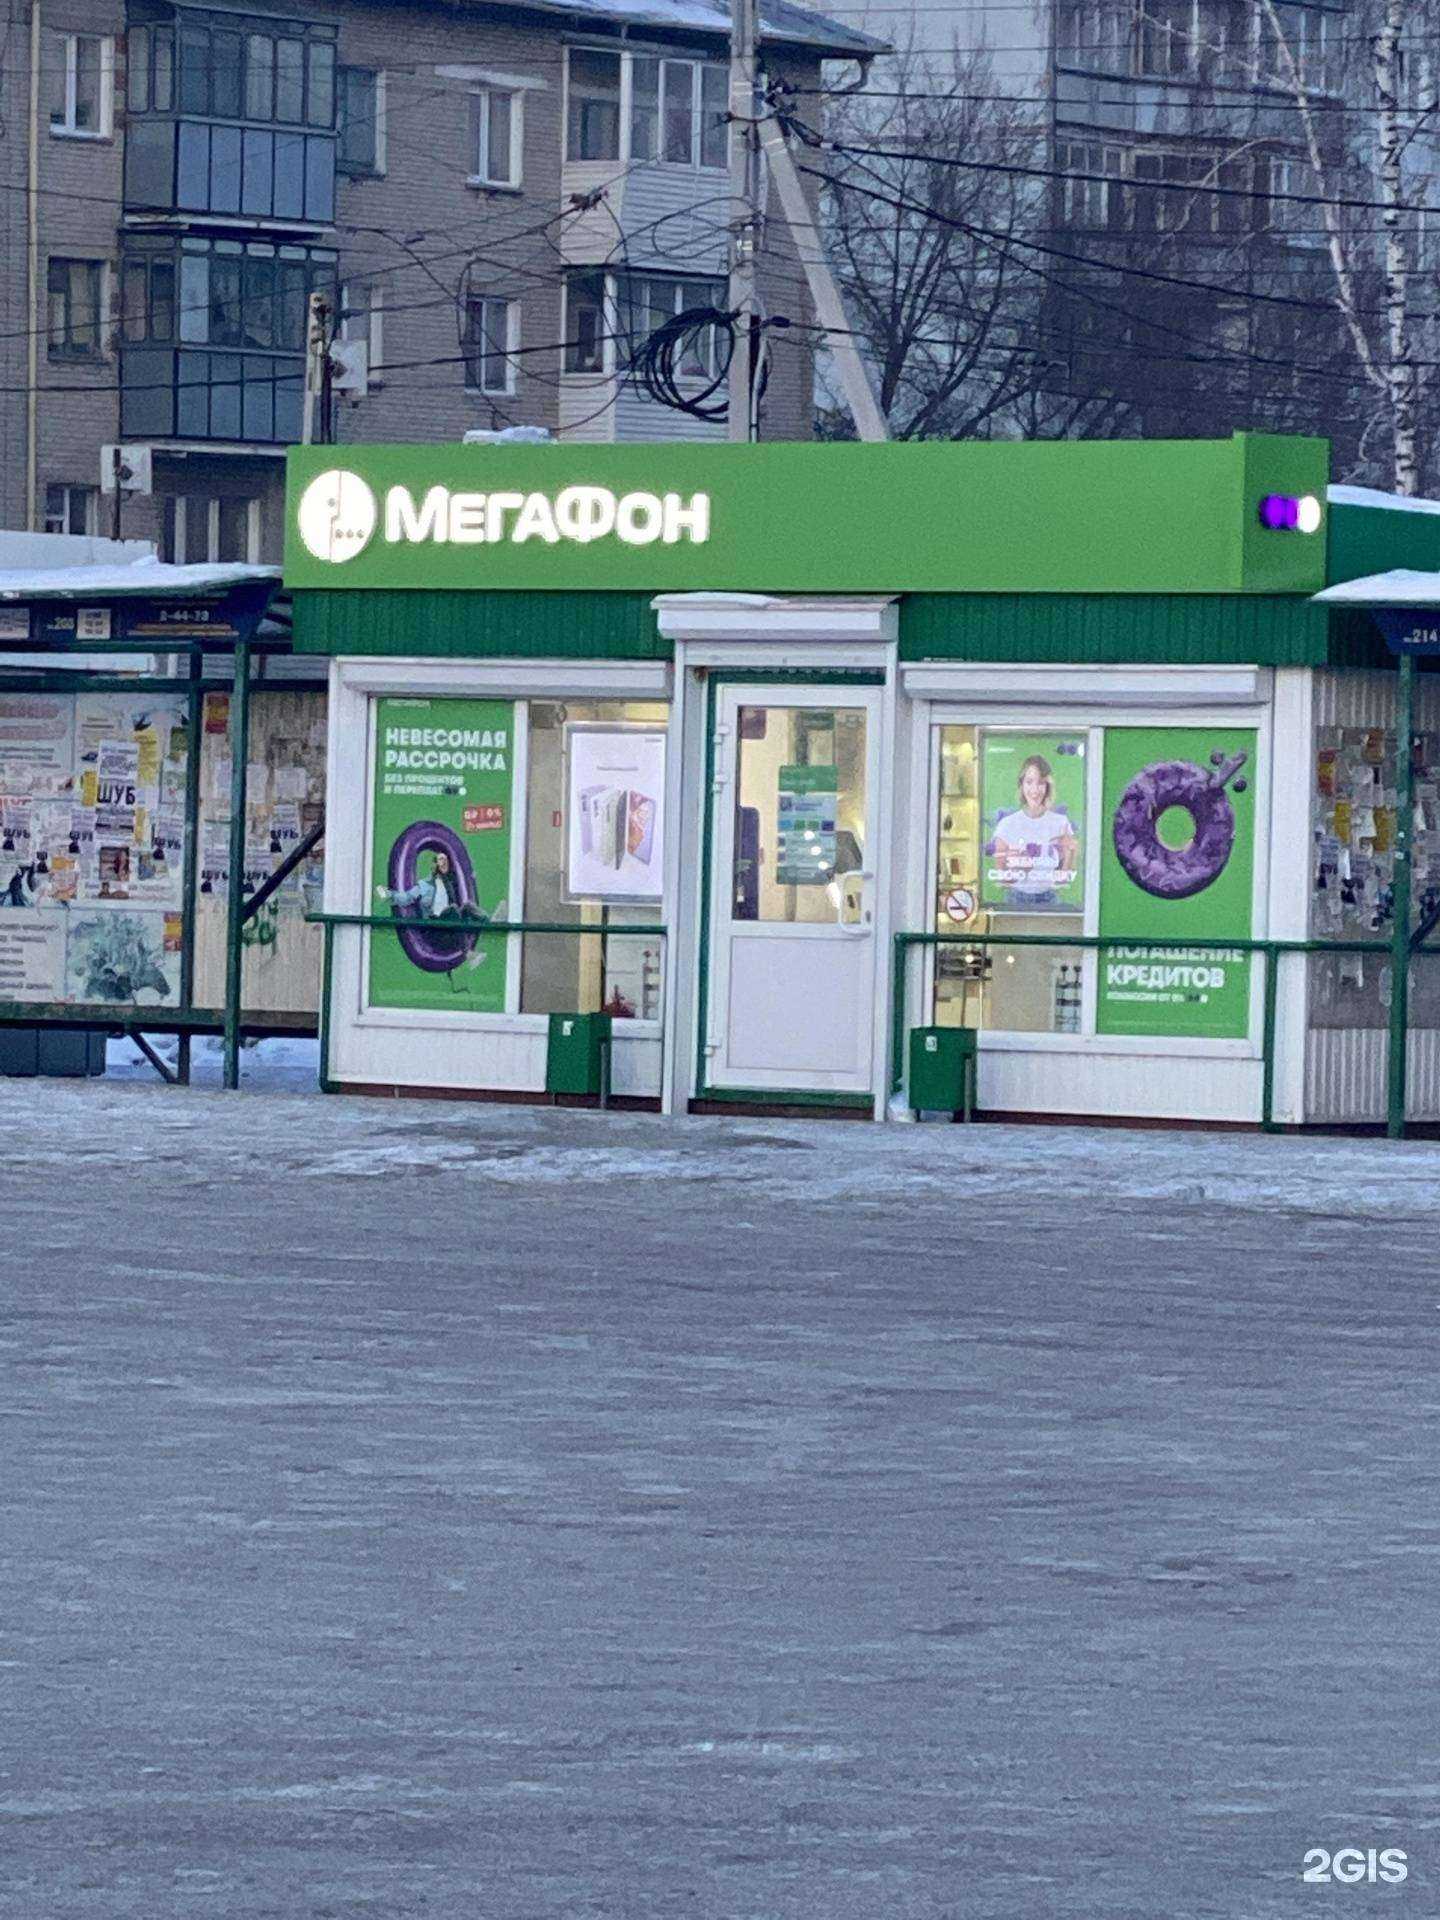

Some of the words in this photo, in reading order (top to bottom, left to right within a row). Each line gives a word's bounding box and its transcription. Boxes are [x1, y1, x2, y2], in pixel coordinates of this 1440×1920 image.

[386, 727, 507, 749] НЕВЕСОМАЯ
[385, 749, 507, 770] РАССРОЧКА
[96, 783, 136, 805] ШУБ
[1106, 964, 1226, 988] КРЕДИТОВ
